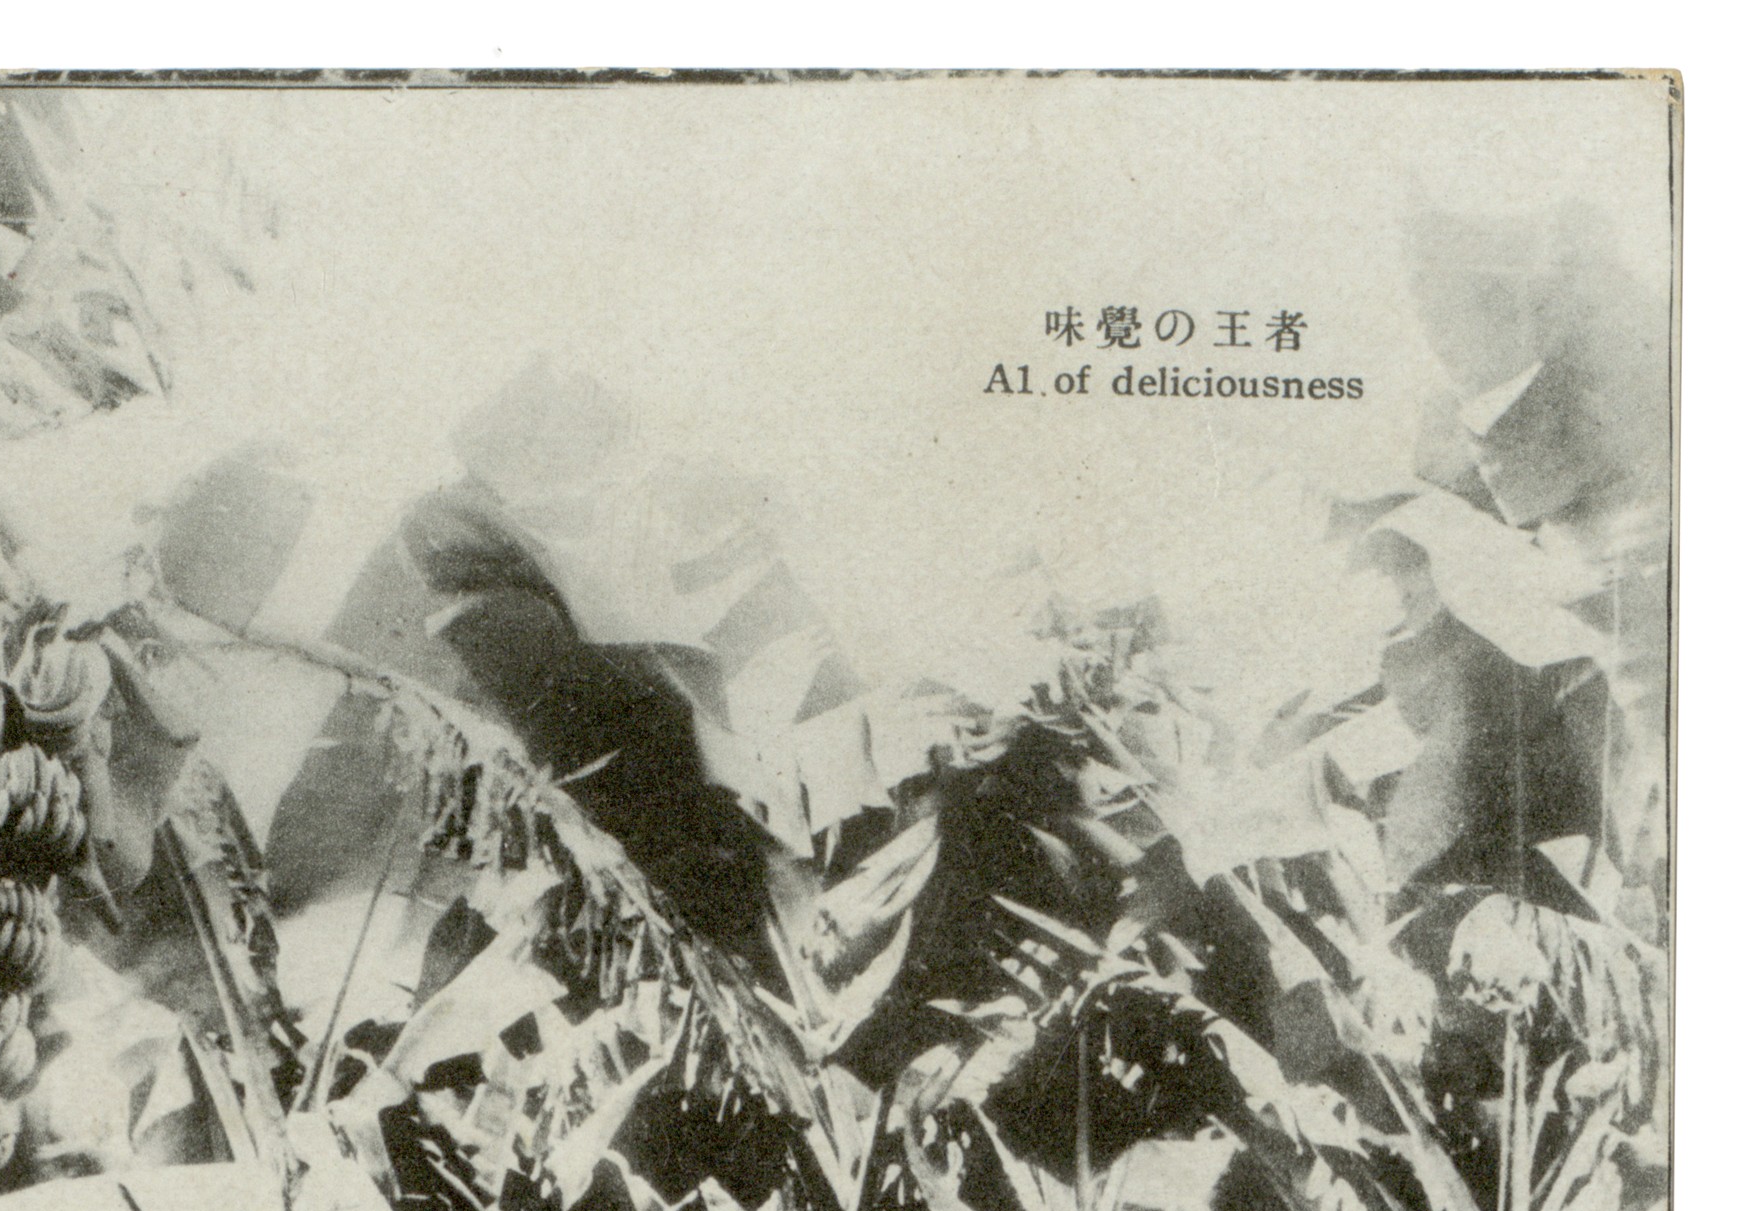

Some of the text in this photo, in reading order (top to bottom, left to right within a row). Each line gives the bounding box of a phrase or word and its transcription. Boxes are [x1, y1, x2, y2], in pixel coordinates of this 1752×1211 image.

[1045, 304, 1308, 353] 味覺の王者
[1054, 364, 1092, 395] of
[1112, 365, 1364, 400] deliciousness
